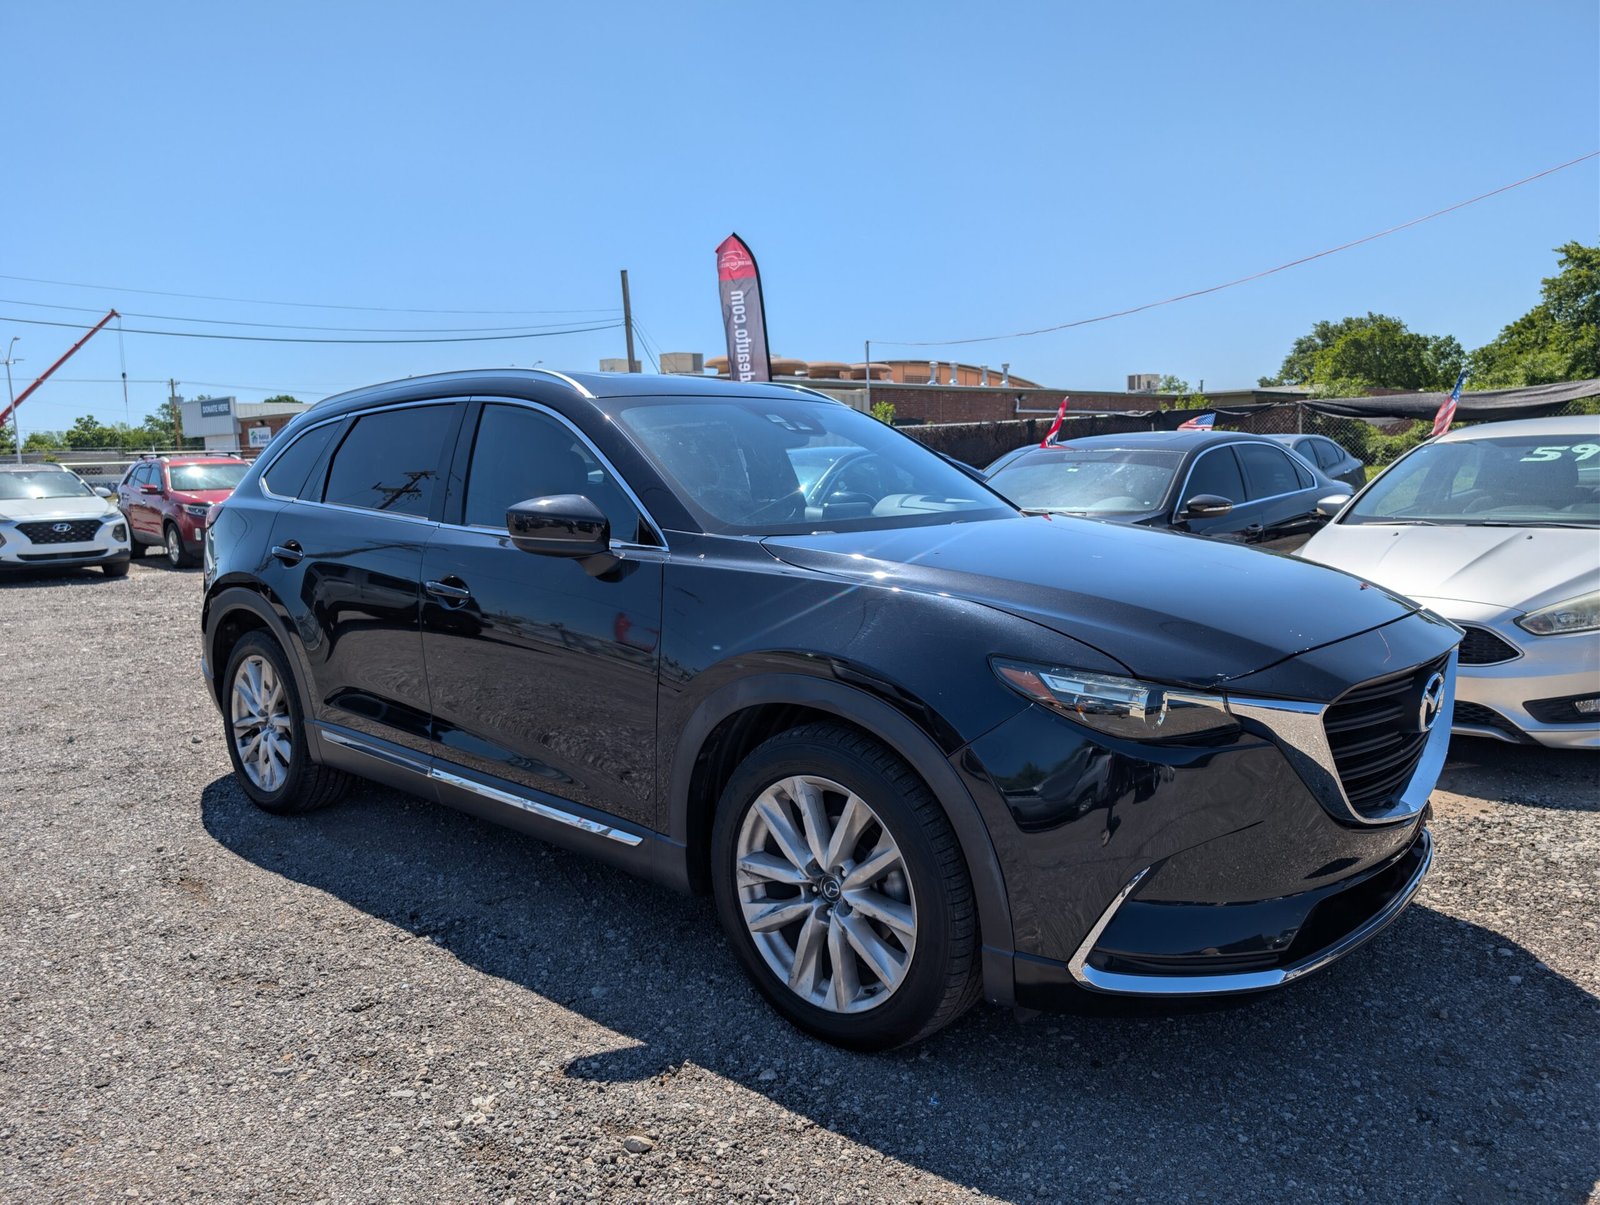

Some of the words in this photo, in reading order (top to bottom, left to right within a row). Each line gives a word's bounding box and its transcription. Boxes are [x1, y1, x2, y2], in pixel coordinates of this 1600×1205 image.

[202, 404, 218, 414] DONATE
[218, 402, 229, 412] HERE
[1519, 443, 1600, 462] 59
